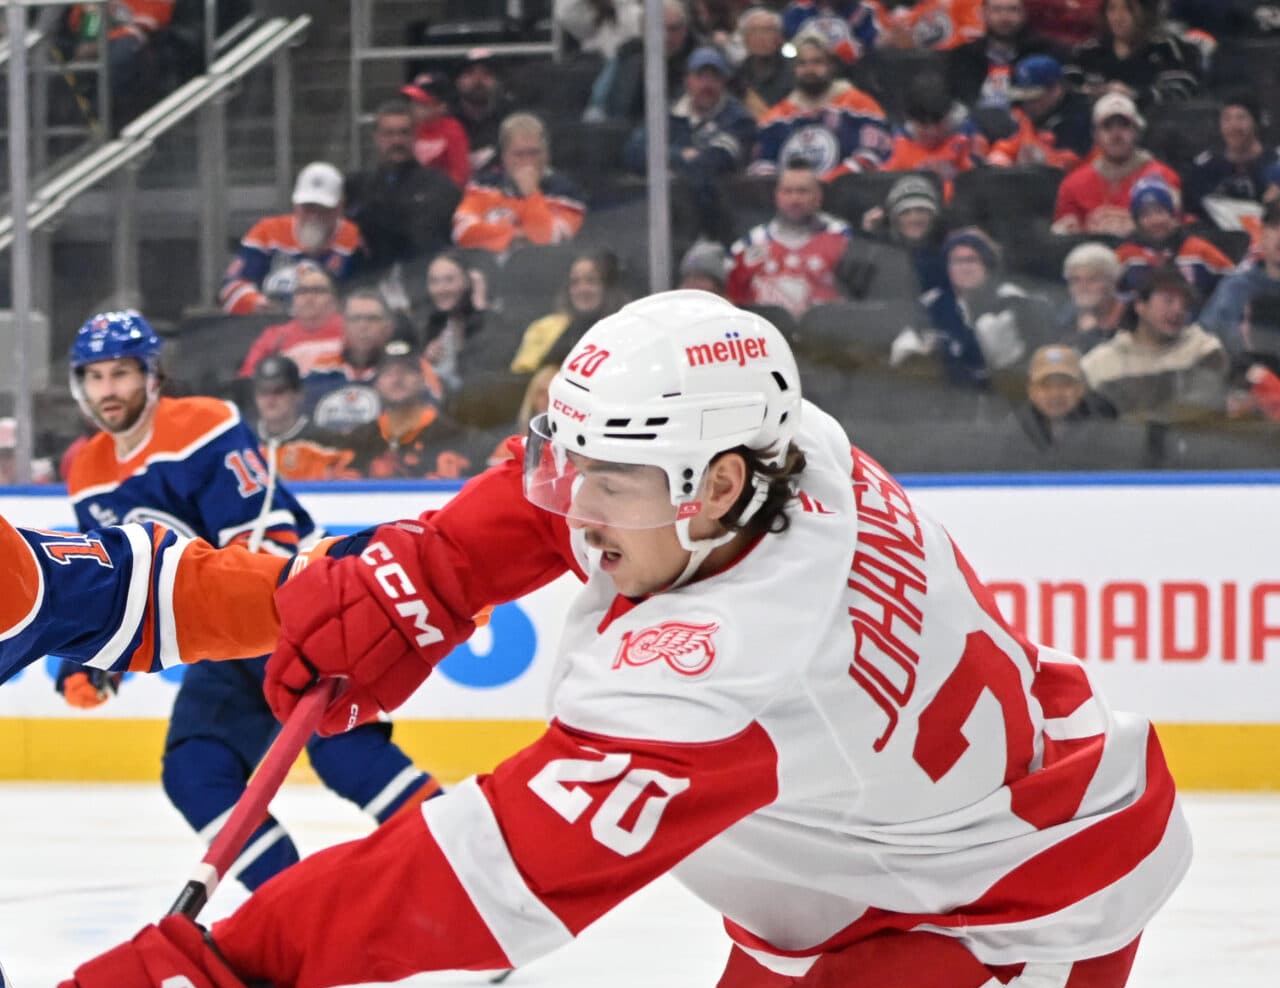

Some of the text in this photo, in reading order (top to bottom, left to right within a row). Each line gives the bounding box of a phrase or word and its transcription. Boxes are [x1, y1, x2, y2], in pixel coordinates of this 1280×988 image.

[567, 344, 609, 378] 20
[685, 332, 768, 366] meijer
[553, 399, 586, 422] CCM
[360, 541, 444, 647] CCM
[527, 746, 691, 857] 20
